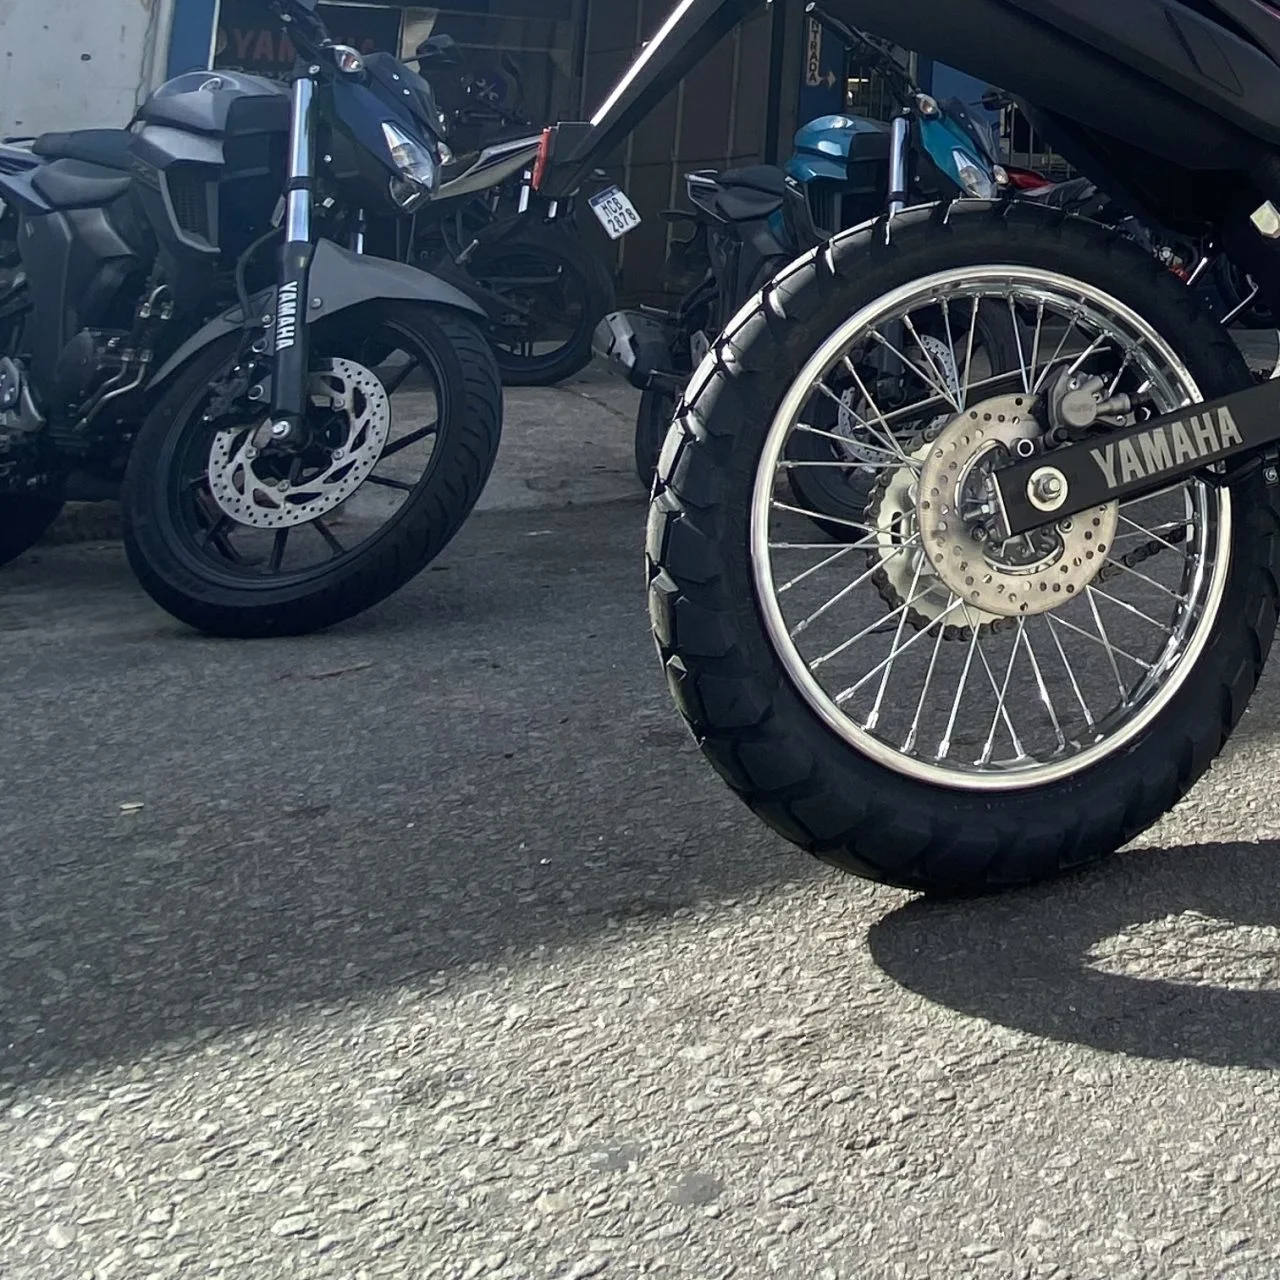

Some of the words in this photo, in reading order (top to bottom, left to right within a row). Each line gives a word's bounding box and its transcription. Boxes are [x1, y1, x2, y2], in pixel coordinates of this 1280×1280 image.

[809, 19, 819, 83] NTRADA
[607, 208, 637, 234] 2878
[275, 280, 298, 351] YAMAHA
[1089, 406, 1243, 489] YAMAHA
